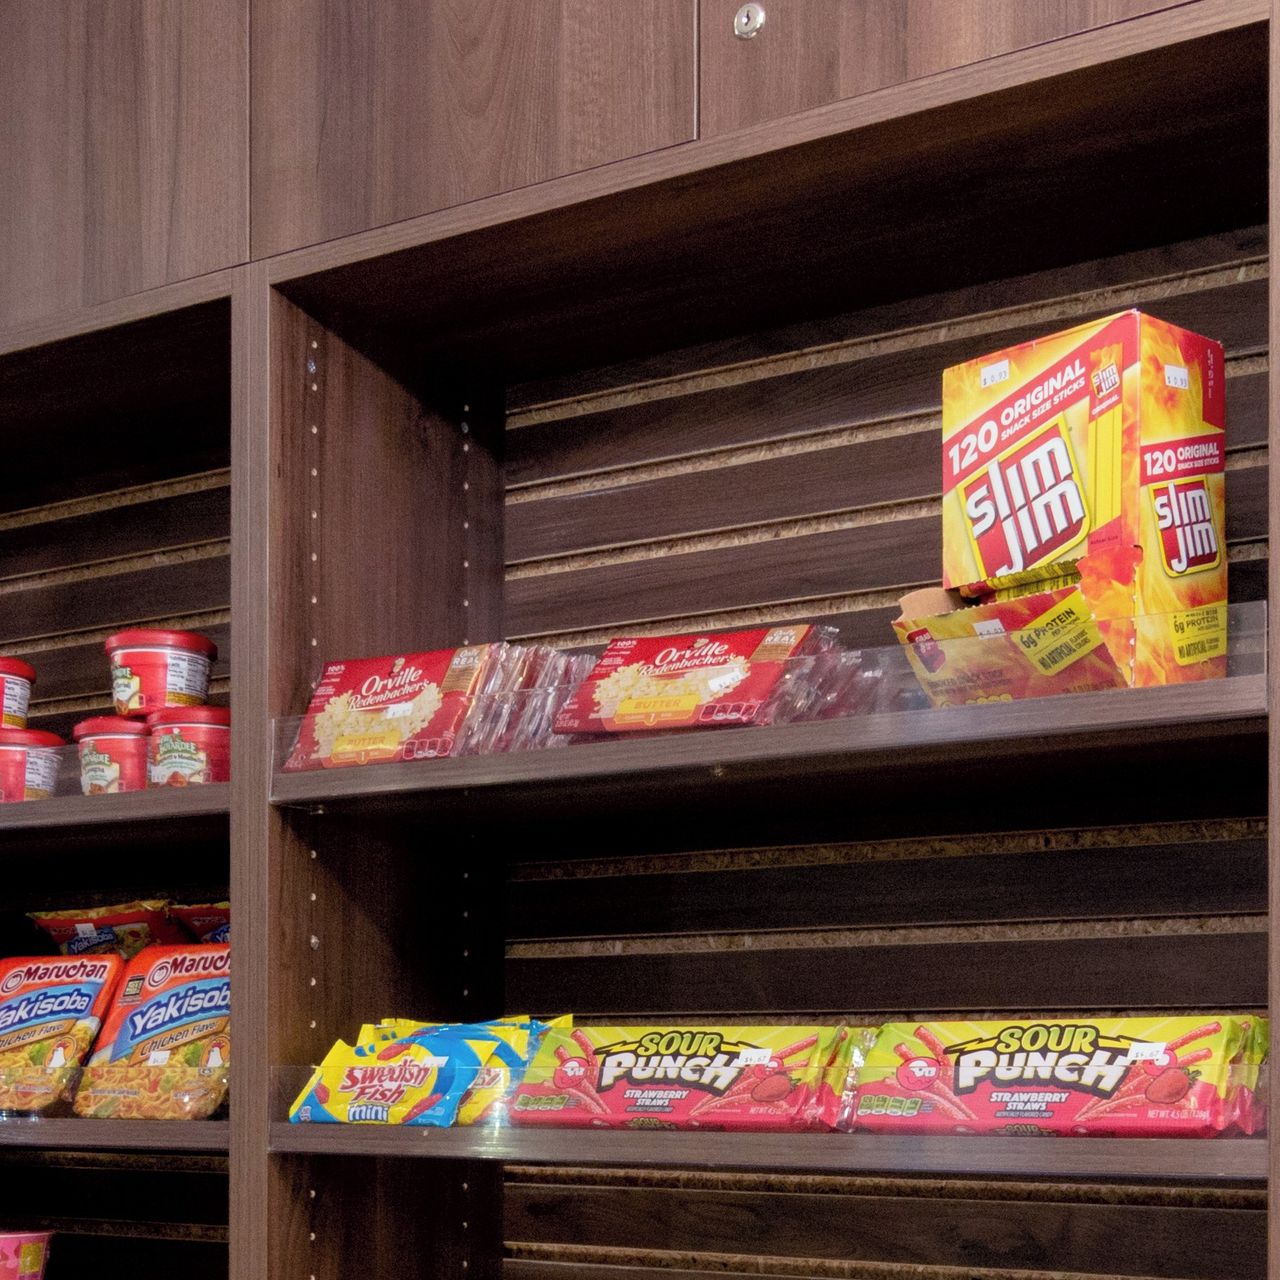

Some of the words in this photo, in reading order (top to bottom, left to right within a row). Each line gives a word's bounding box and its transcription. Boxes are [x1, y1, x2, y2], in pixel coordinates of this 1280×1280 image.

[1000, 358, 1086, 426] ORIGINAL
[1053, 376, 1086, 404] STICKS
[949, 420, 998, 476] 120
[1177, 442, 1219, 459] ORIGINAL
[1144, 448, 1176, 477] 120
[1033, 607, 1076, 638] PROTEIN
[655, 642, 729, 666] Orville
[362, 666, 423, 696] Orville
[23, 960, 108, 983] Maruchan
[640, 1032, 721, 1058] SOUR
[997, 1026, 1095, 1052] SOUR
[597, 1053, 743, 1092] PUNCH
[957, 1052, 1126, 1089] PUNCH
[624, 1089, 689, 1101] STRAWBERRY
[635, 1097, 671, 1106] STRAWS
[990, 1092, 1068, 1104] STRAWBERRY
[1006, 1102, 1046, 1112] STRAWS
[347, 1103, 389, 1122] mini
